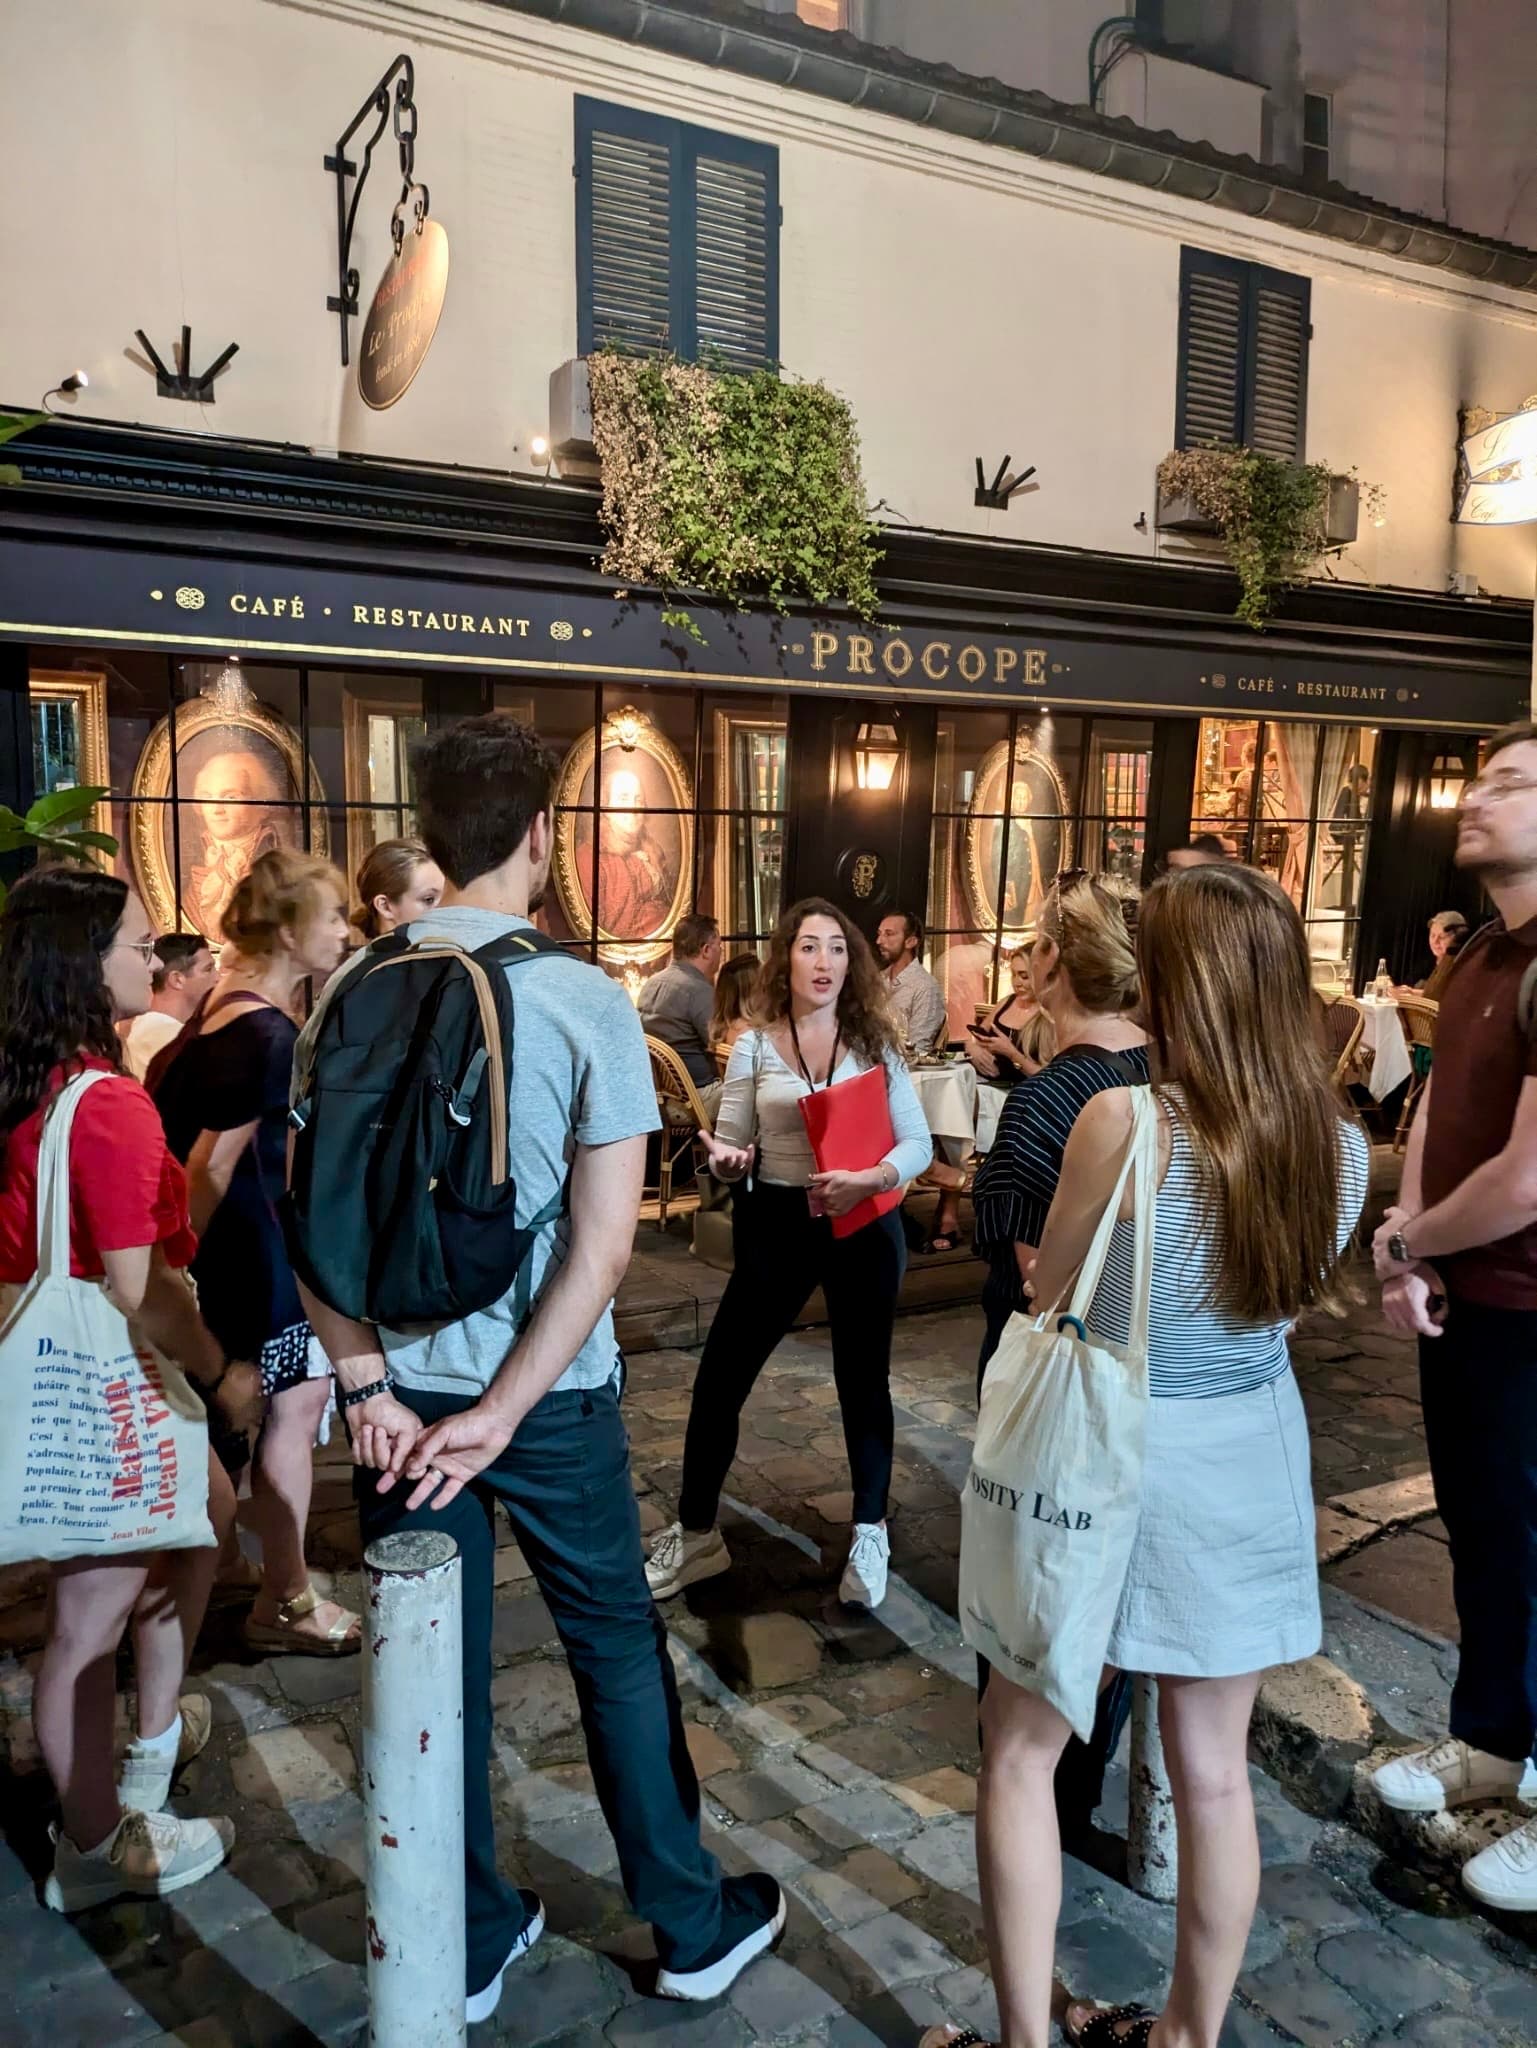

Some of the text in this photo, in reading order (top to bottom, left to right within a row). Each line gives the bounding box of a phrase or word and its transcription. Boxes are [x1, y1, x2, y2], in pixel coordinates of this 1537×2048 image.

[230, 594, 530, 636] CAFÉ RESTAURANT
[809, 631, 1048, 686] PROCOPE
[1237, 676, 1388, 701] CAFÉ RESTAURANT
[34, 1363, 81, 1377] certaines
[33, 1380, 71, 1391] théâtre
[31, 1398, 59, 1409] aussi
[52, 1416, 72, 1427] que
[27, 1447, 75, 1460] s'adresse
[40, 1483, 82, 1496] premier
[63, 1501, 85, 1512] Tout
